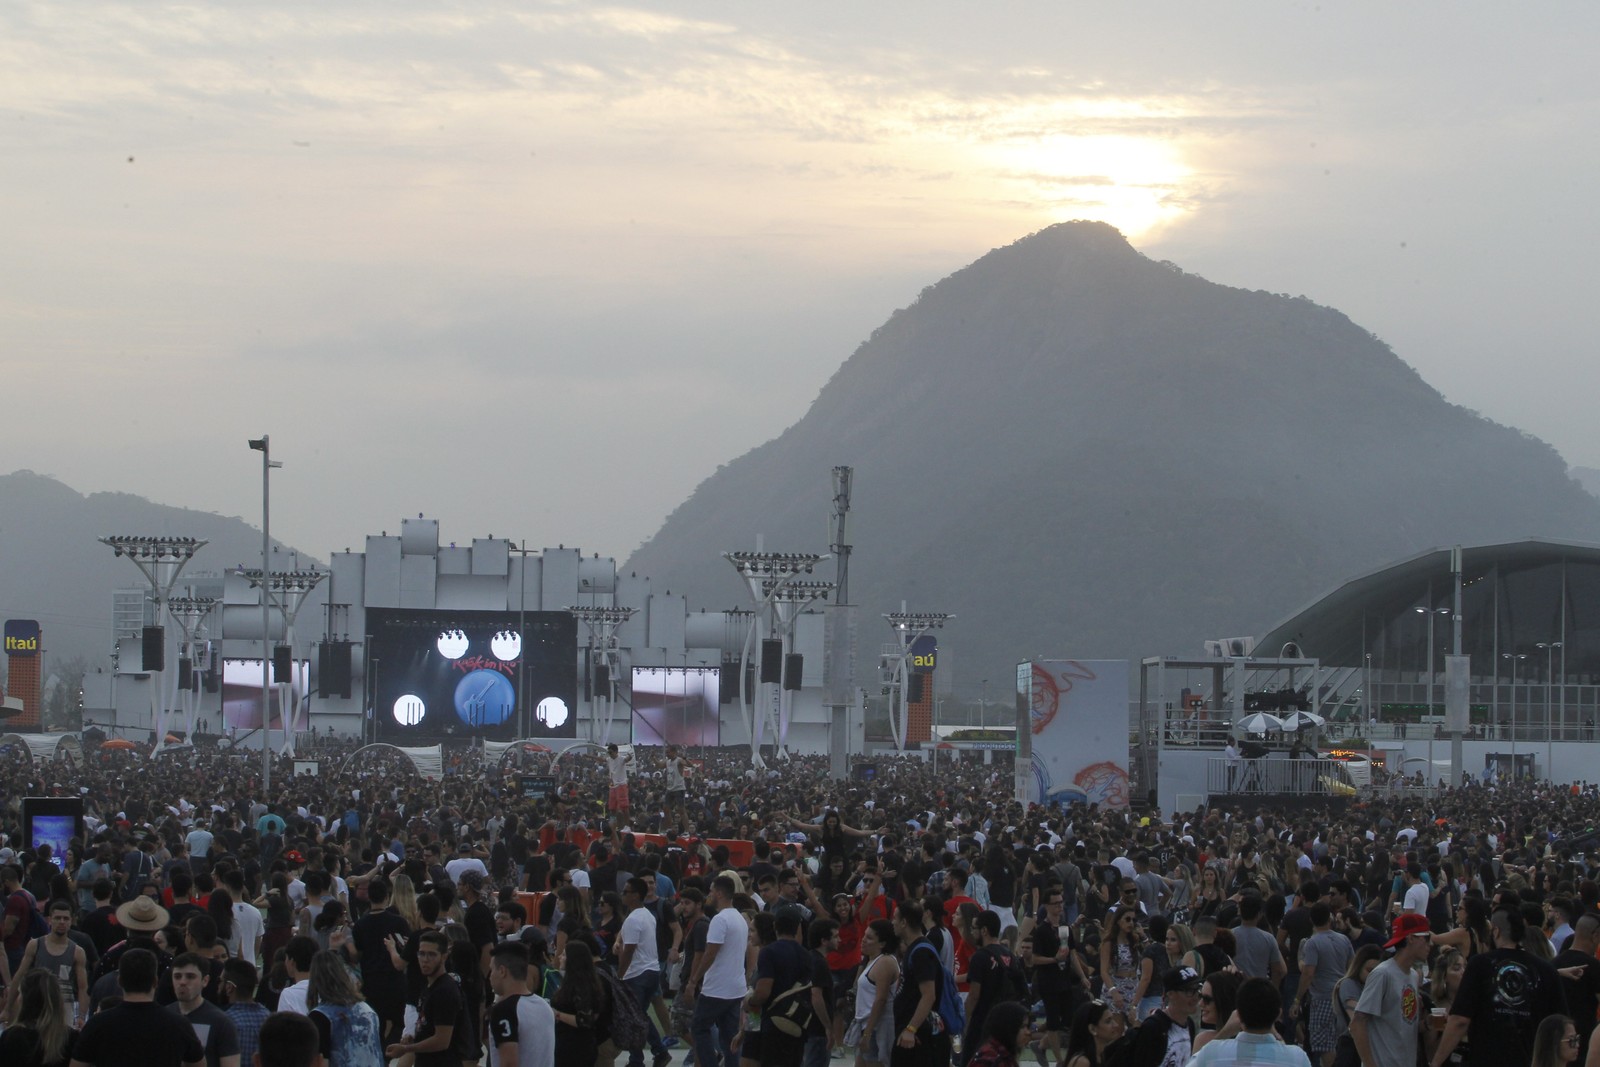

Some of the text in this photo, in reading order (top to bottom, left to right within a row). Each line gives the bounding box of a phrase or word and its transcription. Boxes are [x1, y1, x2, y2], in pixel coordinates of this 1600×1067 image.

[6, 636, 37, 650] Itaú
[912, 653, 935, 667] aú
[499, 1019, 512, 1038] 3
